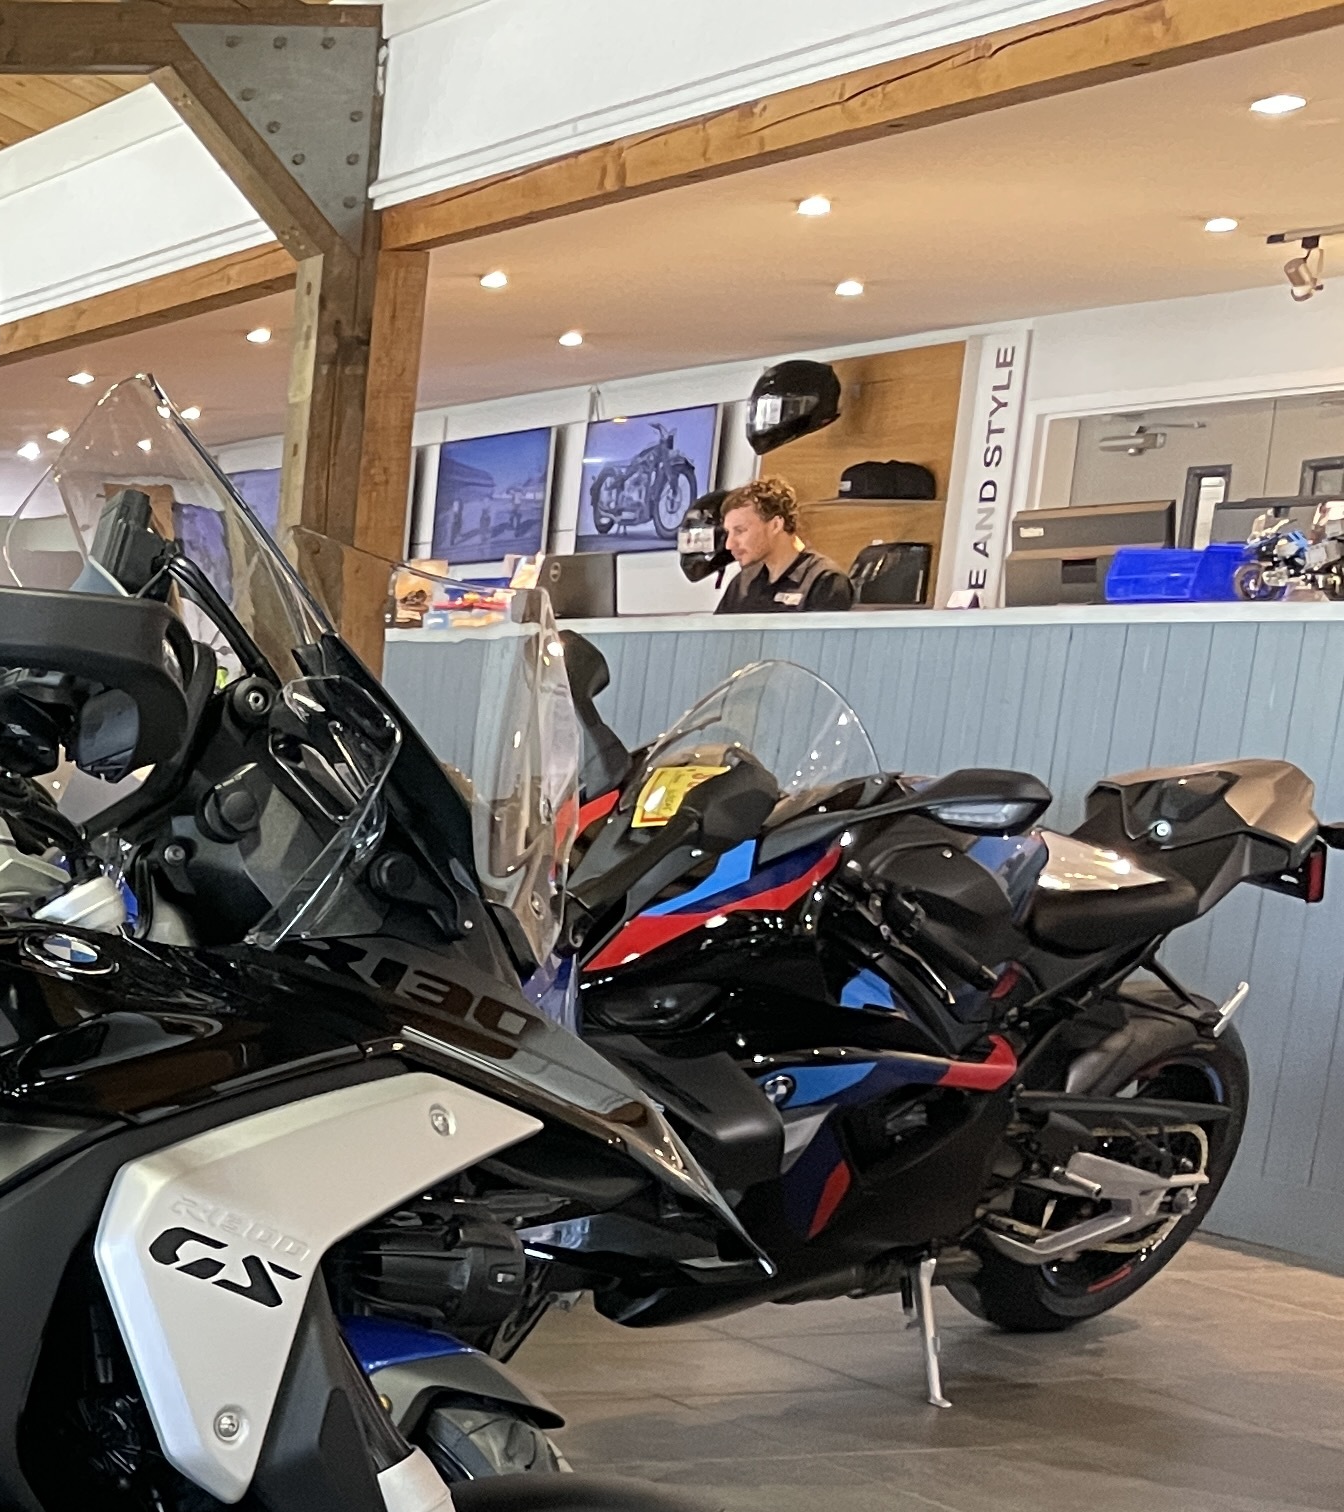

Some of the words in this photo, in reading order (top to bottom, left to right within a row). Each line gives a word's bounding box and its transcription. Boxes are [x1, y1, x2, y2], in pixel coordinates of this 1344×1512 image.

[983, 346, 1015, 468] STYLE
[973, 479, 998, 558] AND
[148, 1226, 303, 1308] GS
